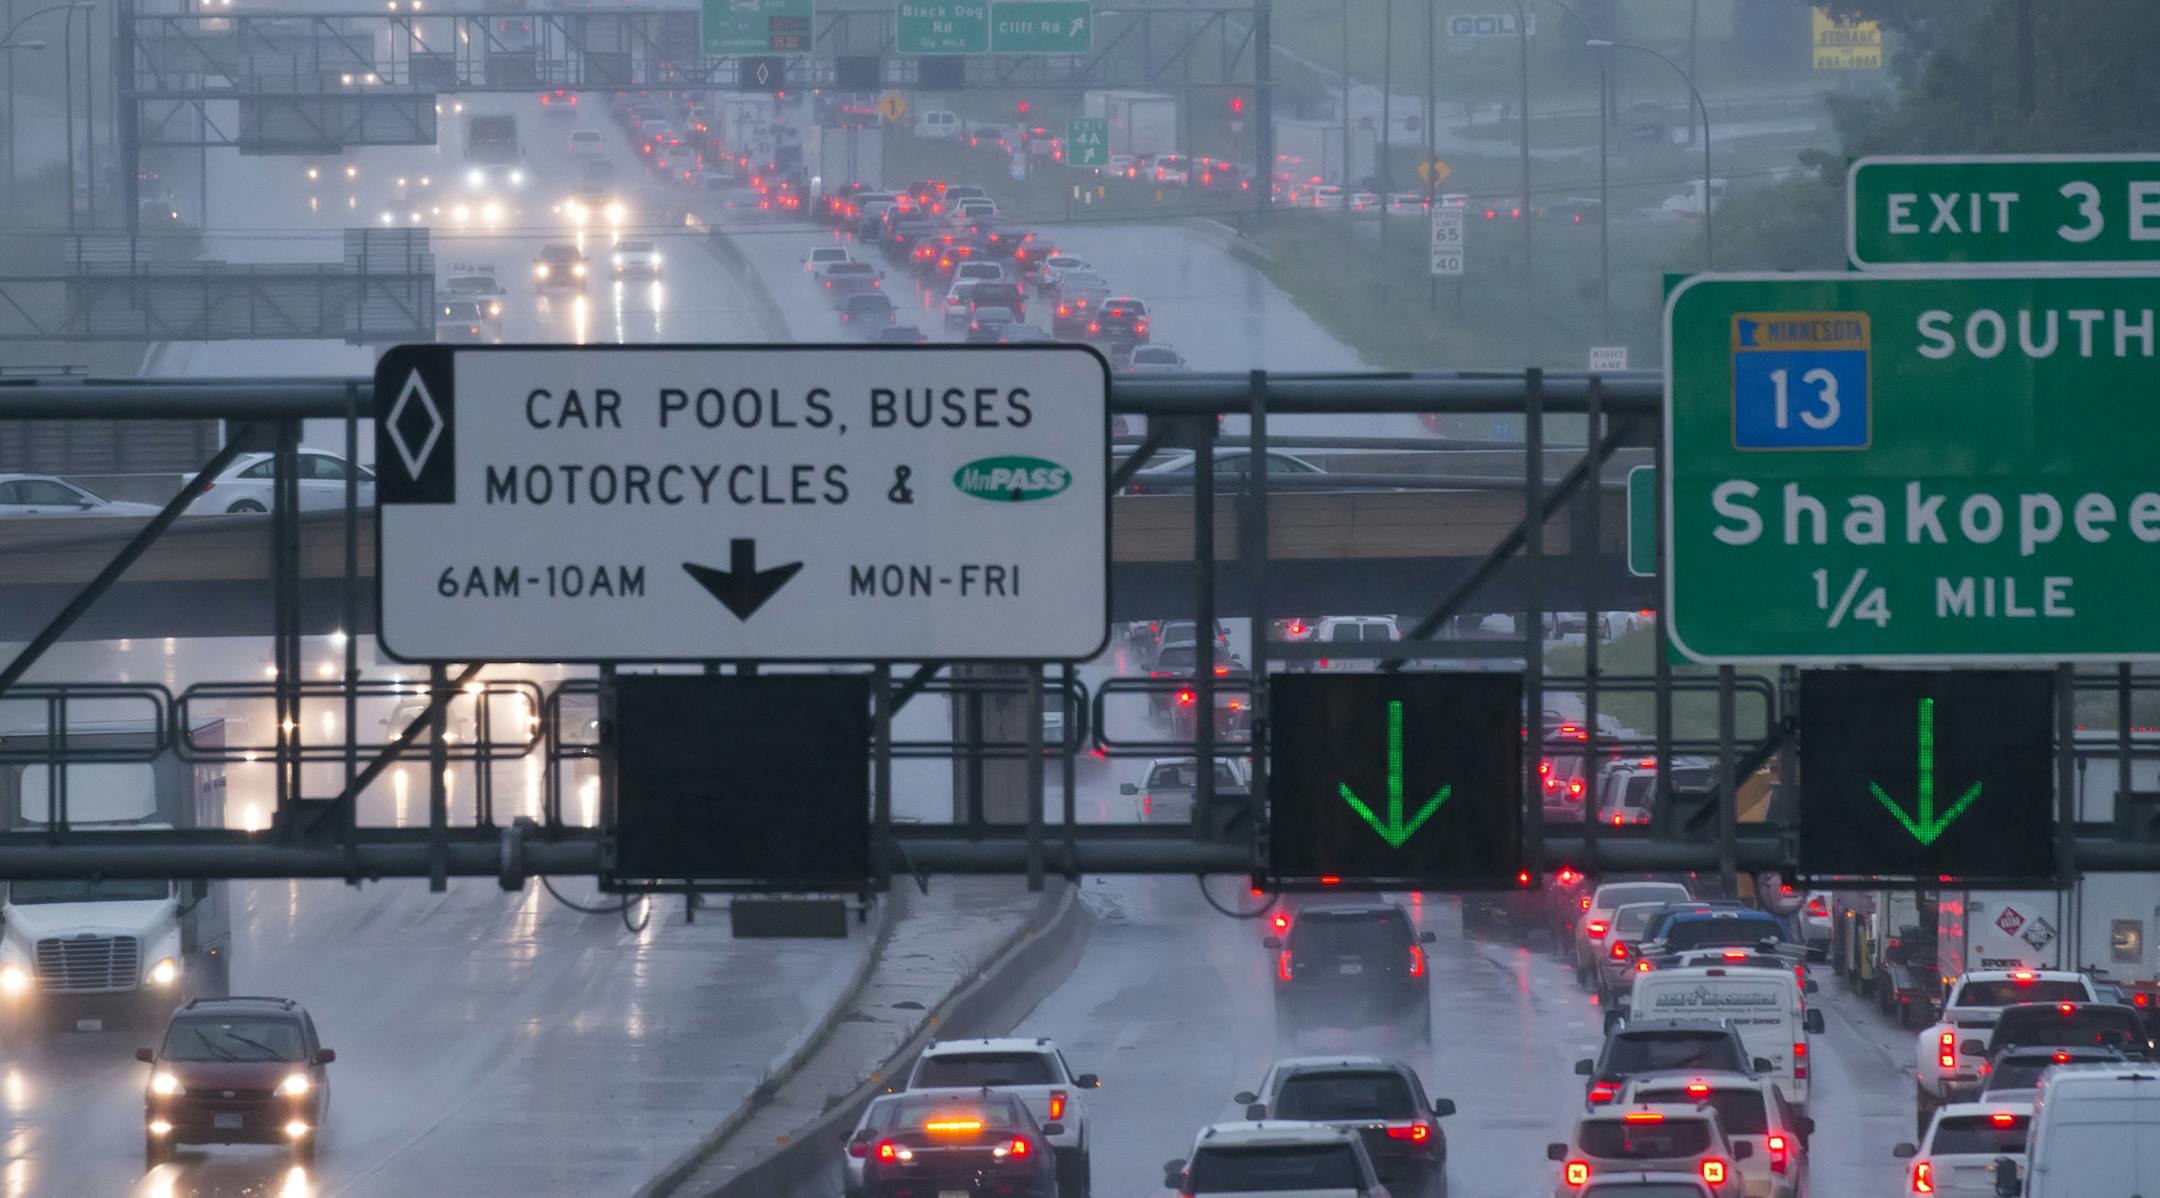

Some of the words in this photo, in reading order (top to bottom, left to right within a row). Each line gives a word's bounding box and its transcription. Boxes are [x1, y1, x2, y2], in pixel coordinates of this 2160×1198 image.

[902, 5, 946, 17] Black
[955, 5, 984, 19] Dog
[932, 22, 953, 33] Rd
[999, 21, 1032, 34] Cliff
[1040, 21, 1061, 34] Rd
[1076, 132, 1100, 145] 4A
[1888, 192, 2019, 234] EXIT
[1436, 228, 1458, 241] 65
[1436, 258, 1458, 270] 40
[1767, 320, 1863, 342] MINNESOTA
[1916, 308, 2155, 359] SOUTH
[525, 388, 622, 429] CAR
[659, 387, 848, 436] POOLS,
[870, 387, 1033, 429] BUSES
[1768, 367, 1841, 430] 13
[486, 464, 850, 505] MOTORCYCLES
[887, 464, 914, 505] &
[961, 466, 1067, 491] MnPASS
[1711, 479, 2160, 556] Shakopee
[437, 565, 646, 598] 6AM-10AM
[850, 565, 1020, 598] MON-FRI
[1811, 567, 1891, 628] 1/4
[1935, 576, 2075, 618] MILE
